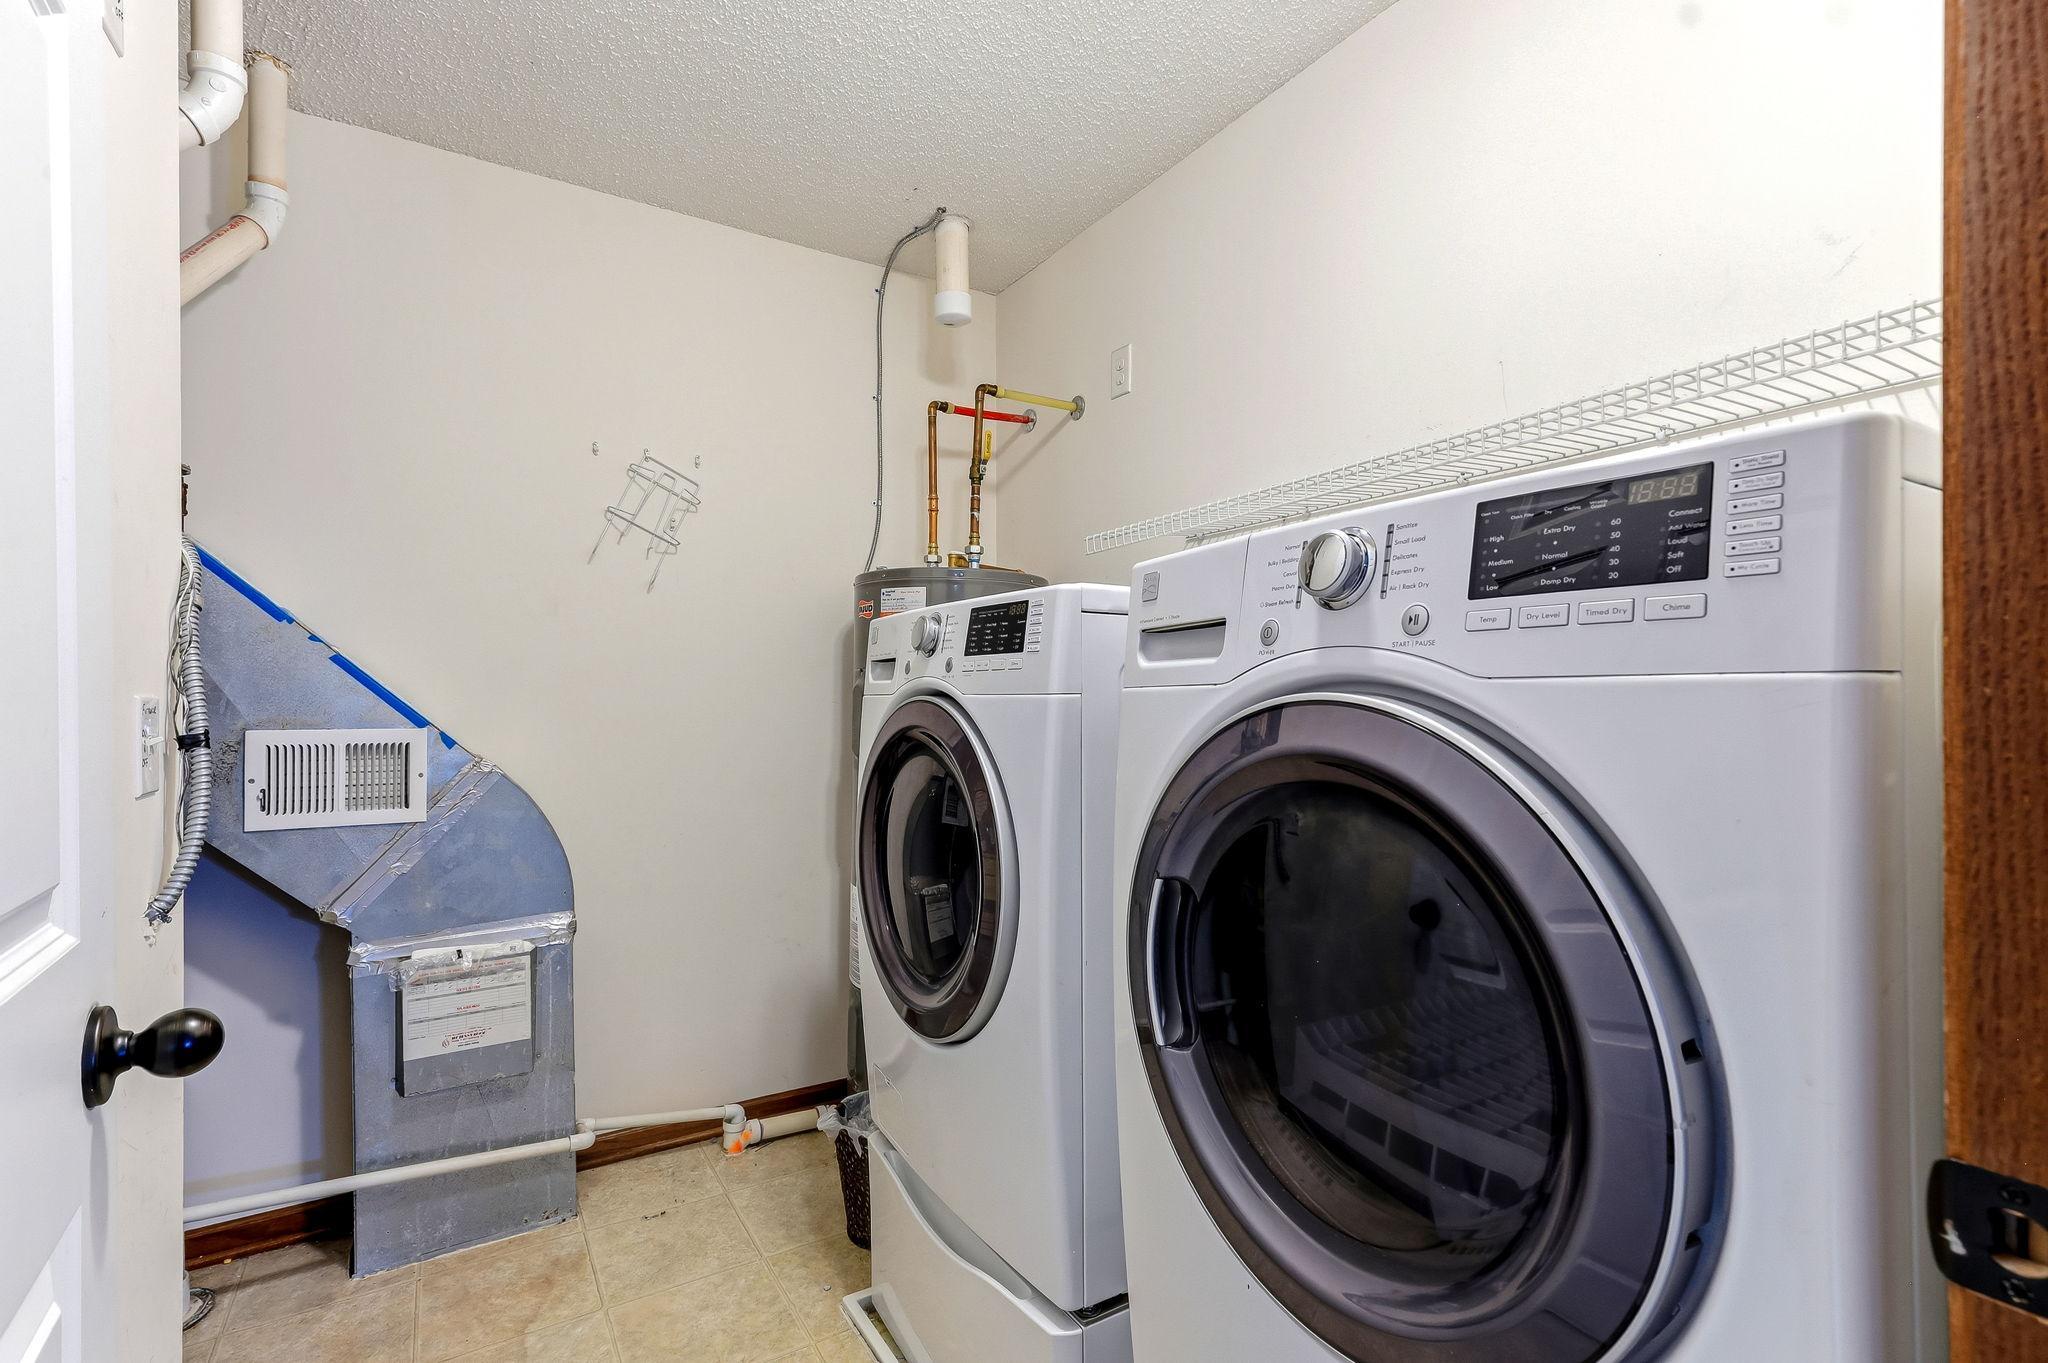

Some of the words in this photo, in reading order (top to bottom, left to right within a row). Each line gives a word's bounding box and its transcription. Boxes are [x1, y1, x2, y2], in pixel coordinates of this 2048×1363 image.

[1668, 507, 1703, 517] Connect
[1610, 518, 1622, 526] 60
[1543, 527, 1562, 535] Extra
[1563, 525, 1577, 533] Dry
[1489, 534, 1505, 543] High
[1609, 531, 1621, 539] 50
[1667, 536, 1689, 545] Loud
[1541, 551, 1569, 561] Normal
[1667, 550, 1685, 559] Soft
[1487, 558, 1514, 567] Medium
[1608, 558, 1620, 566] 30
[1666, 565, 1682, 574] Off
[1608, 571, 1619, 579] 20
[1540, 577, 1562, 586] Damp
[1585, 608, 1610, 617] Timed
[1612, 606, 1628, 616] Dry
[1662, 603, 1691, 612] Chime
[1479, 615, 1498, 625] Temp
[1526, 612, 1541, 622] Dry
[1541, 611, 1561, 620] Level
[1391, 640, 1410, 648] START
[1415, 639, 1436, 647] PAUSE
